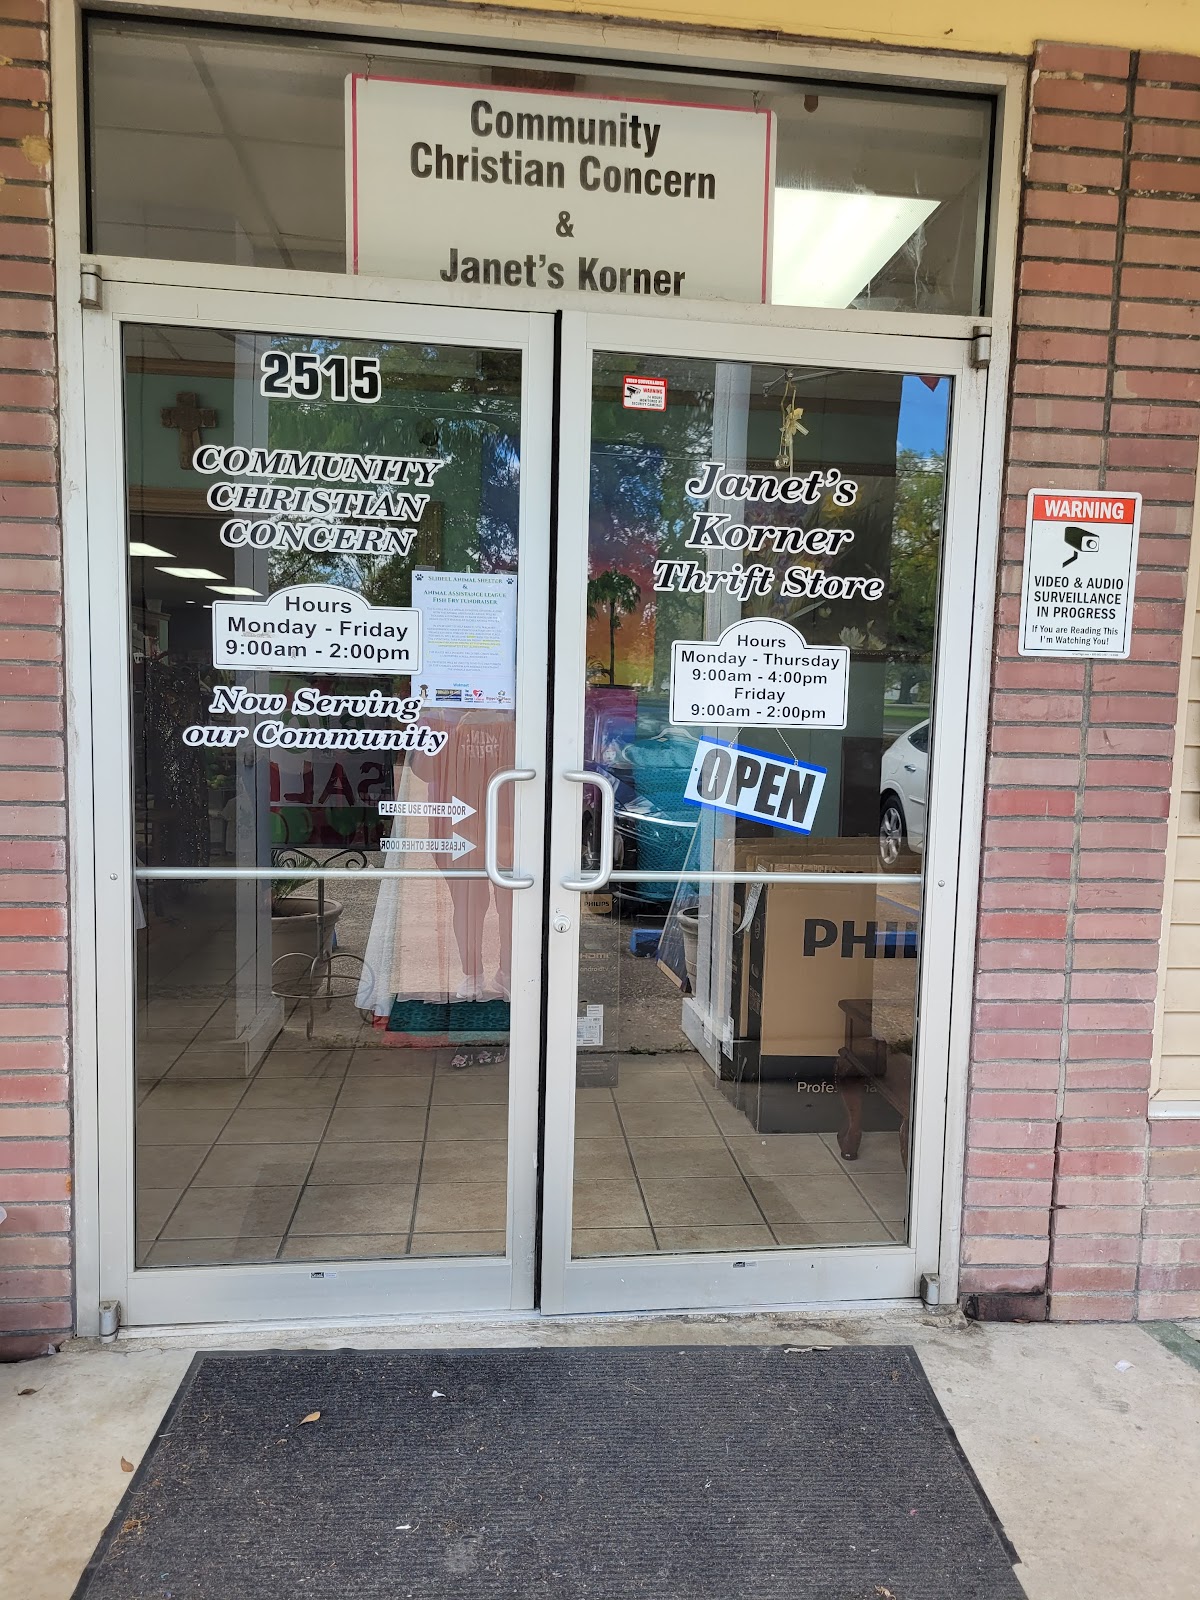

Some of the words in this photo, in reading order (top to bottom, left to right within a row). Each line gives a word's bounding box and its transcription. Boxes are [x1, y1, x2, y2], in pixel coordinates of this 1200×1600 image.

[470, 99, 661, 159] Community
[409, 141, 565, 189] Christian
[579, 155, 717, 200] Concern
[555, 210, 575, 238] &
[439, 247, 564, 290] Janet's
[578, 256, 686, 297] Korner
[260, 350, 382, 404] 2515
[194, 445, 441, 486] COMMUNITY
[685, 461, 858, 506] Janet's
[207, 482, 430, 522] CHRISTIAN
[1044, 499, 1125, 520] WARNING
[220, 518, 418, 557] CONCERN
[685, 512, 854, 555] Korner
[653, 559, 775, 601] Thrift
[781, 564, 885, 601] Store
[1034, 575, 1069, 589] VIDEO
[1073, 577, 1083, 589] &
[1086, 577, 1124, 590] AUDIO
[285, 595, 353, 615] Hours
[1034, 591, 1122, 605] SURVEILLANCE
[1036, 606, 1049, 617] IN
[1053, 607, 1116, 620] PROGRESS
[227, 616, 317, 639] Monday
[339, 620, 409, 642] Friday
[737, 634, 786, 648] Hours
[1032, 625, 1039, 633] If
[1040, 625, 1053, 634] You
[1070, 626, 1102, 636] Reading
[1103, 627, 1119, 636] This
[1040, 635, 1053, 644] I'm
[1055, 636, 1092, 646] Watching
[1092, 637, 1109, 646] You!
[225, 639, 307, 657] 9:00am
[329, 642, 411, 664] 2:00pm
[681, 650, 747, 667] Monday
[763, 653, 840, 670] Thursday
[692, 668, 752, 682] 9:00am
[768, 671, 828, 686] 4:00pm
[211, 686, 286, 714] Now
[292, 688, 425, 723] Serving
[734, 687, 786, 703] Friday
[691, 704, 751, 717] 9:00am
[766, 705, 826, 721] 2:00pm
[185, 723, 247, 748] our
[255, 720, 447, 755] Community
[696, 747, 817, 824] OPEN
[380, 803, 406, 814] PLEASE
[408, 804, 422, 815] USE
[423, 804, 446, 815] OTHER
[447, 805, 466, 816] DOOR
